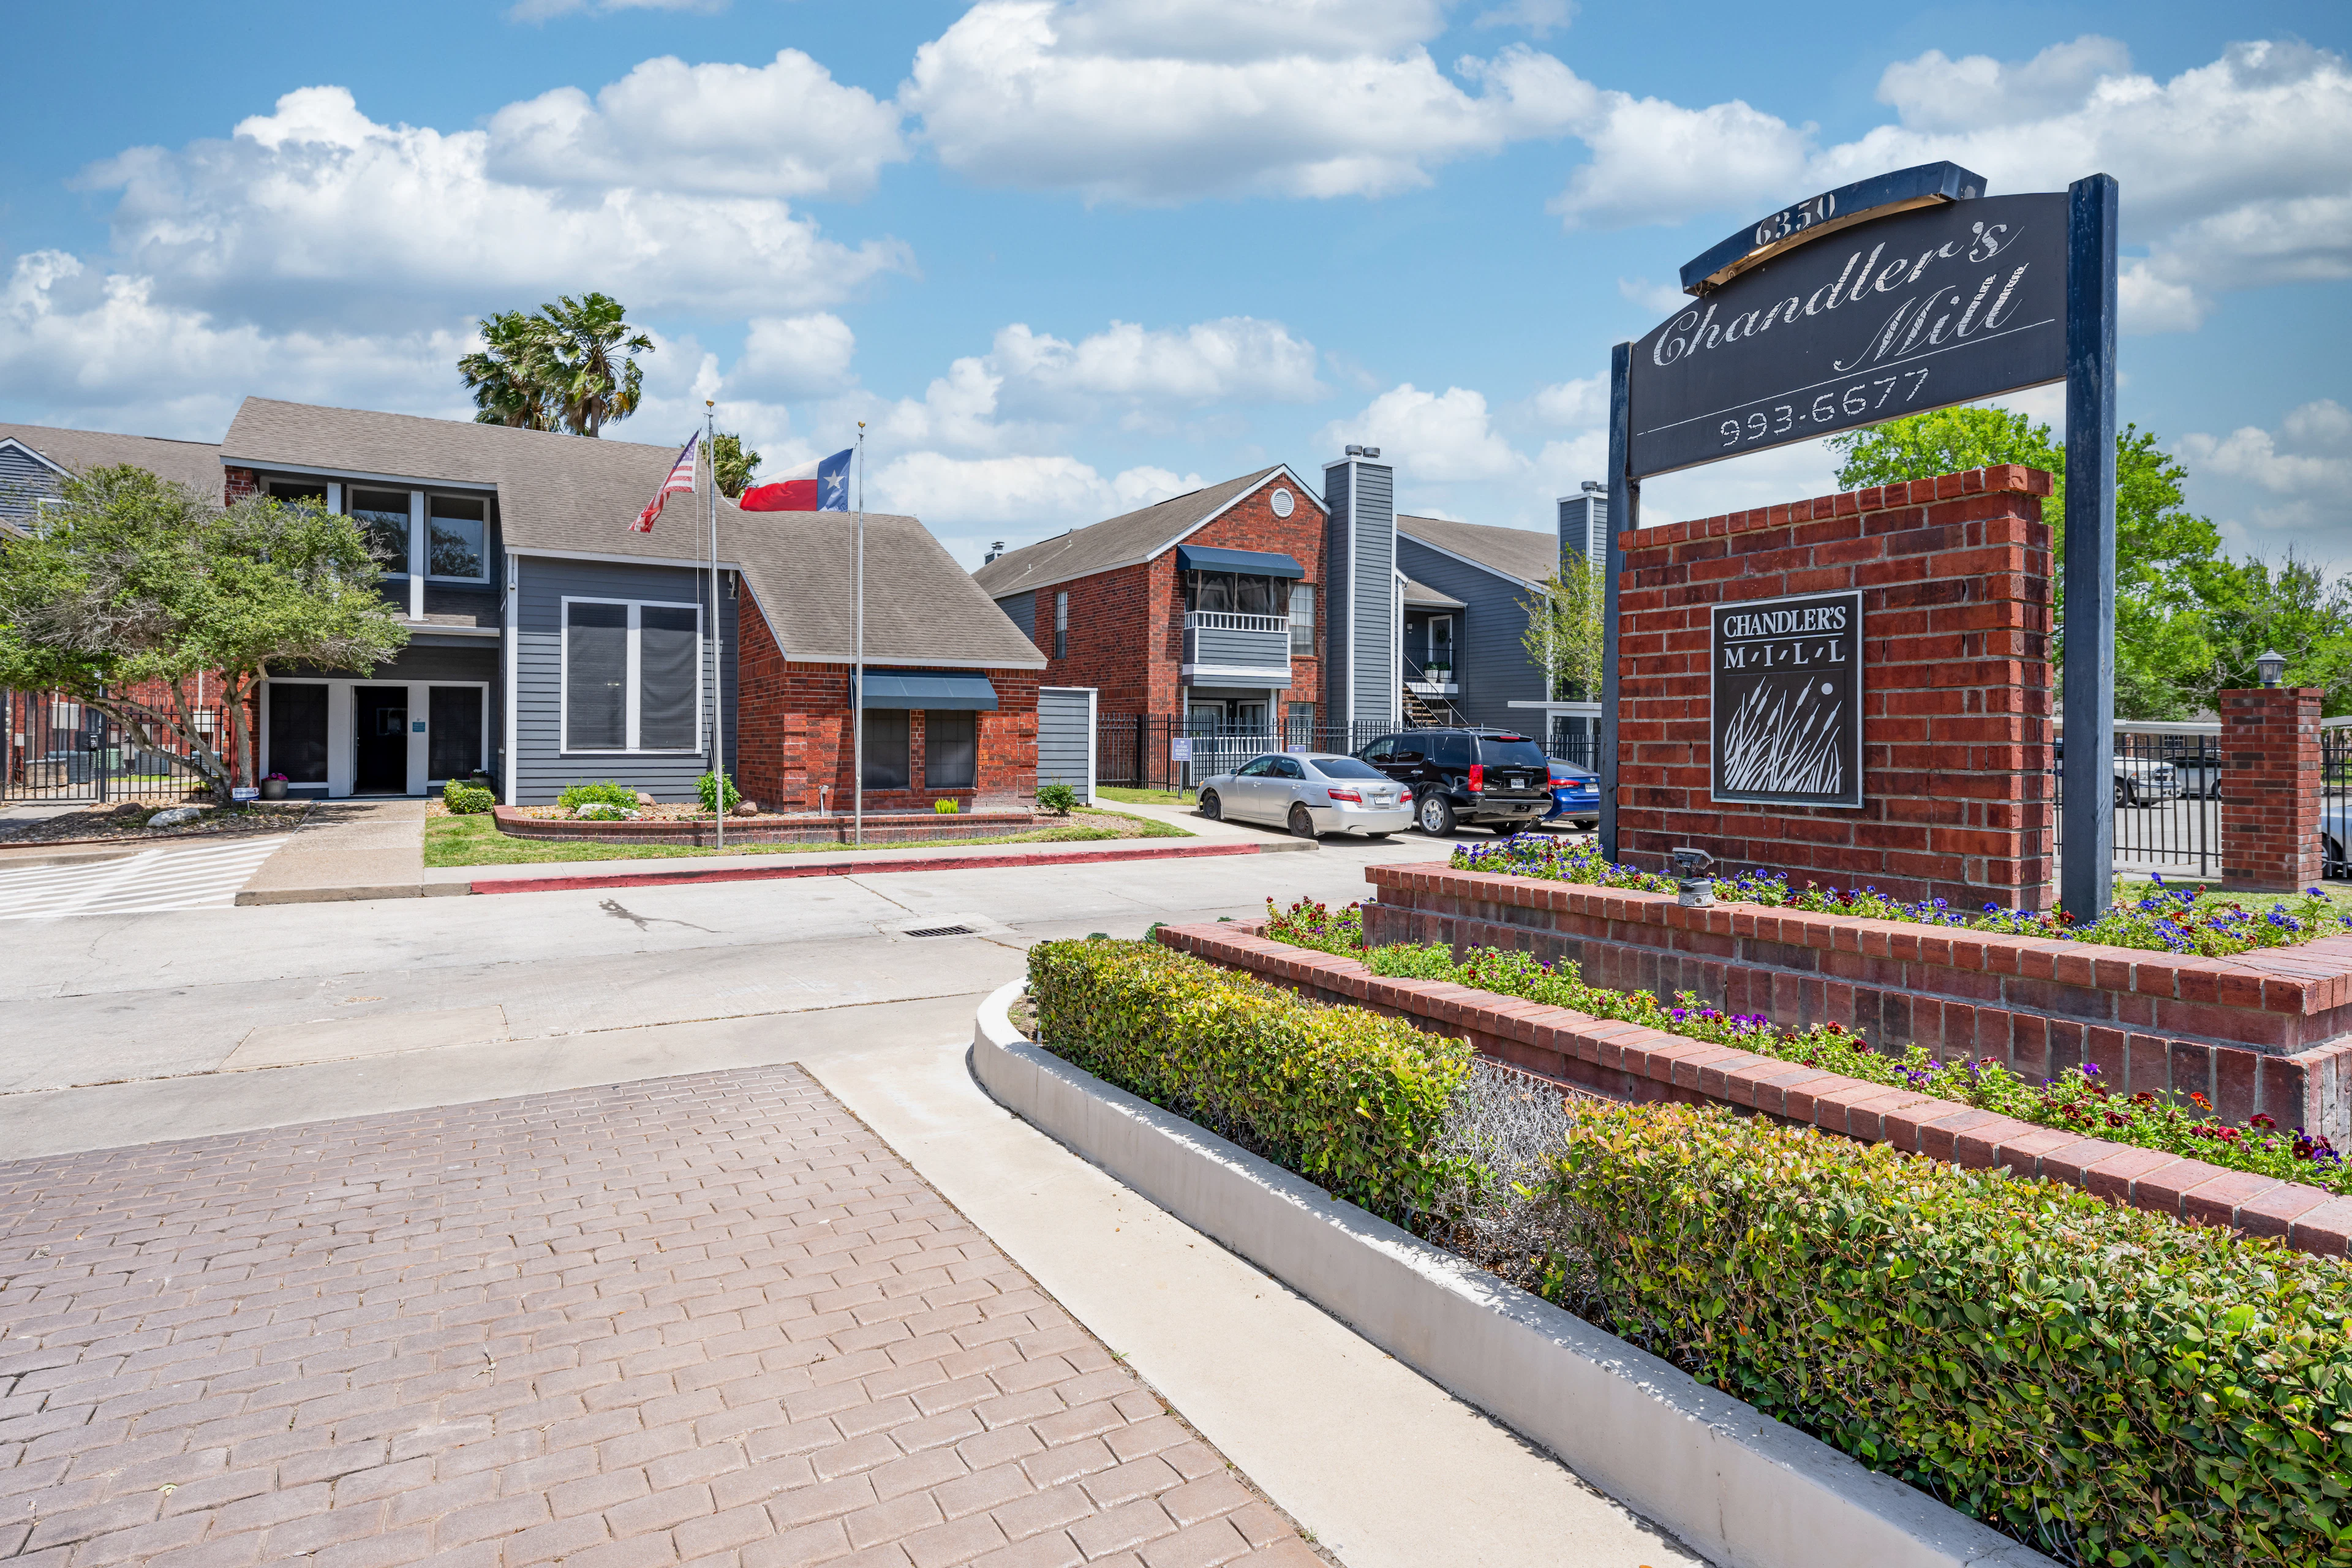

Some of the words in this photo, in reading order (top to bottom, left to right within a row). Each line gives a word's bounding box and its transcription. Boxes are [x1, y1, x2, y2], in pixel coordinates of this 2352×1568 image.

[1755, 192, 1836, 245] 6350
[1653, 221, 2024, 366] Chandler's
[1833, 262, 2030, 371] Mill
[1724, 606, 1846, 638] CHANDLER'S
